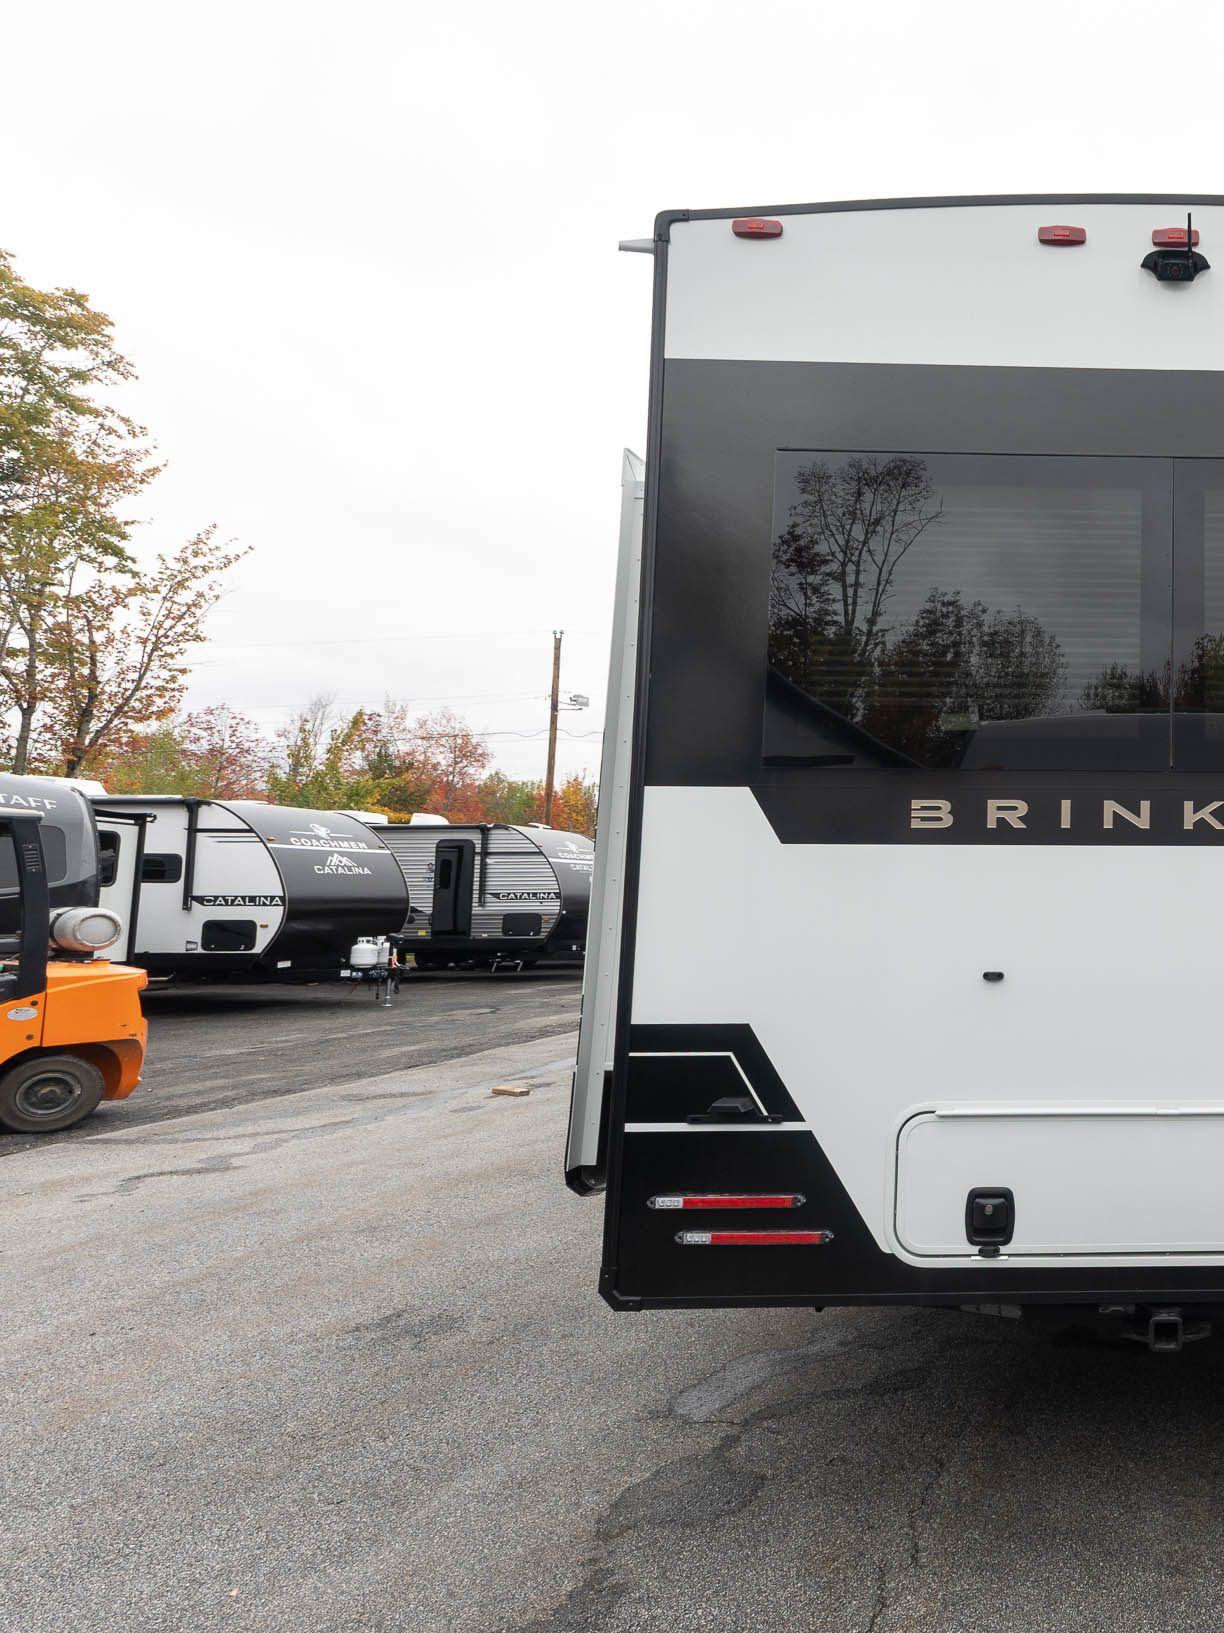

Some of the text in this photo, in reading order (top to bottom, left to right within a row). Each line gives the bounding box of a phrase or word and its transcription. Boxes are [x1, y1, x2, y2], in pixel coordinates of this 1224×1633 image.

[290, 837, 369, 850] COACHMEN
[313, 865, 373, 875] CATALINA
[203, 896, 283, 906] CATALINA
[499, 892, 557, 900] CATALINA
